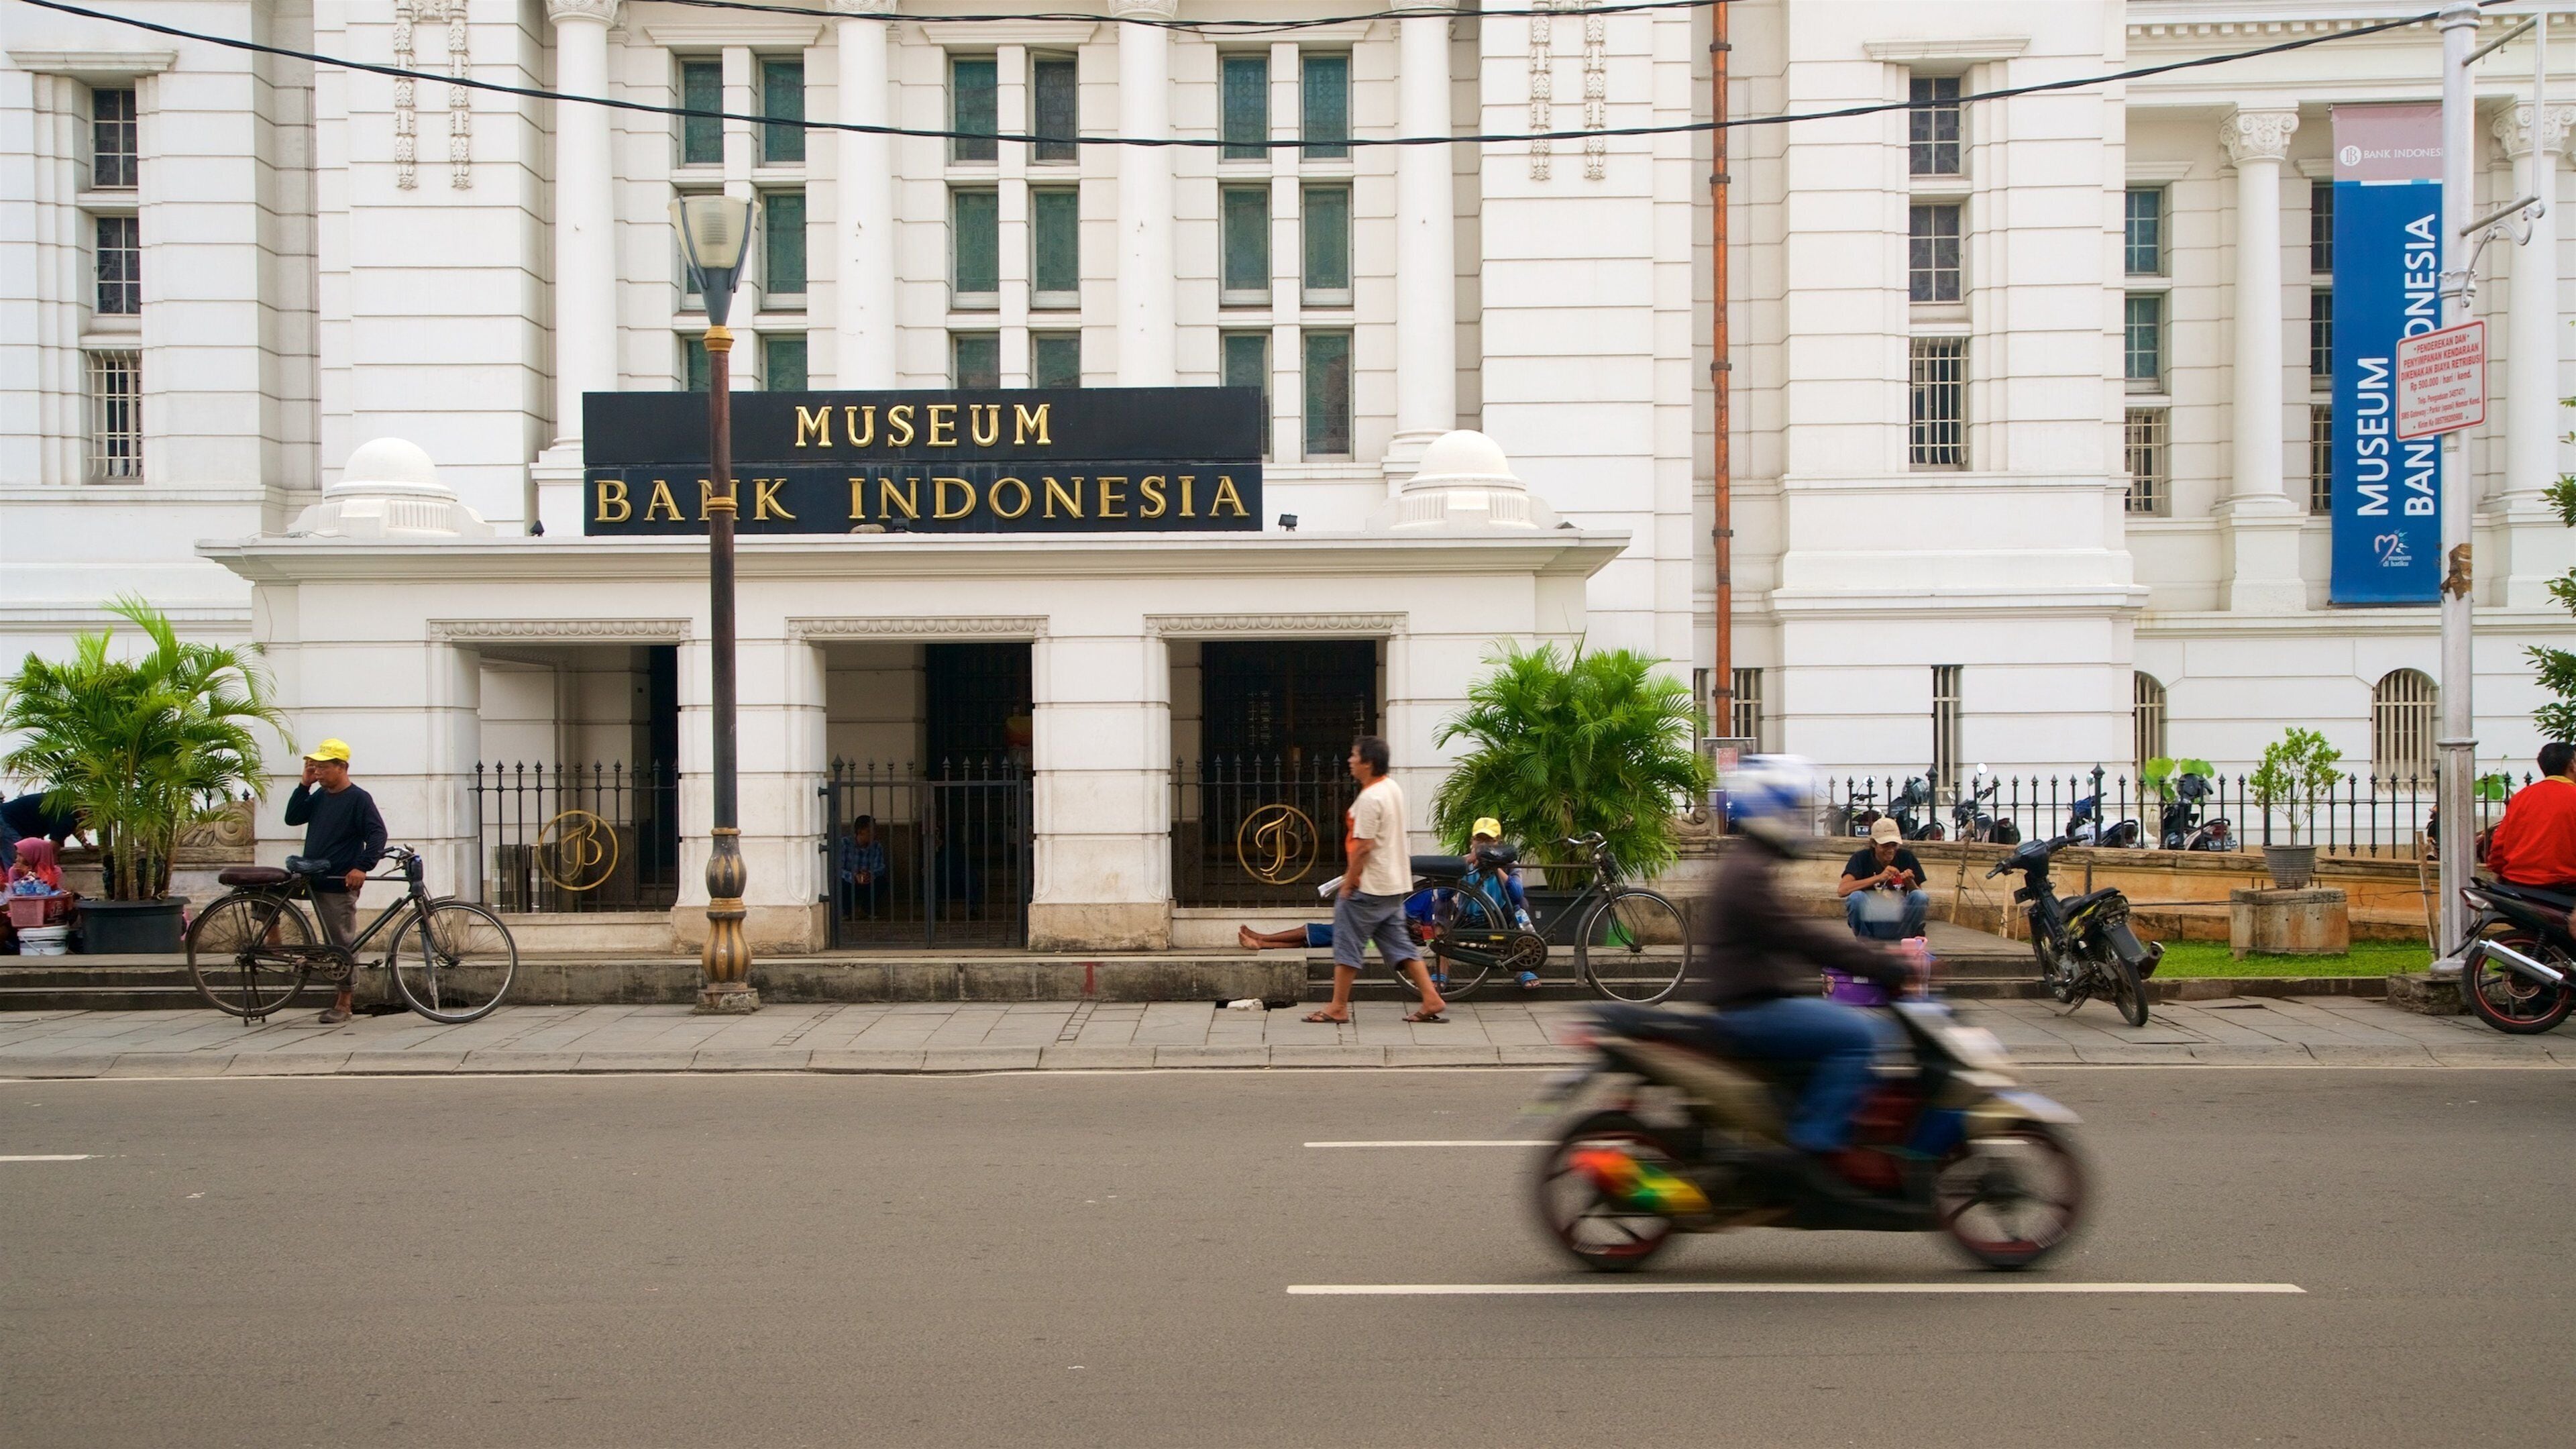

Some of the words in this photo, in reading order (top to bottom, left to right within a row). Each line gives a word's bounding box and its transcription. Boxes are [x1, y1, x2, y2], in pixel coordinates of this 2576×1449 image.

[2363, 149, 2391, 159] BANK
[2394, 147, 2443, 158] INDONESI
[2404, 213, 2436, 339] ONESIA
[2404, 352, 2443, 368] PENYIMPANAN
[2443, 343, 2479, 359] KENDARAAN
[2416, 337, 2453, 354] PENDEREKAN
[2455, 333, 2467, 344] DAN
[2401, 366, 2433, 381] DIKENAKAN
[2434, 362, 2451, 373] BIAYA
[2451, 354, 2482, 369] RETRIBUSI
[2410, 382, 2417, 392] Rp
[2418, 376, 2439, 389] 500.000
[794, 404, 1052, 448] MUSEUM
[2357, 358, 2389, 516] MUSEUM
[2404, 435, 2434, 516] BAN
[848, 475, 1250, 521] INDONESIA
